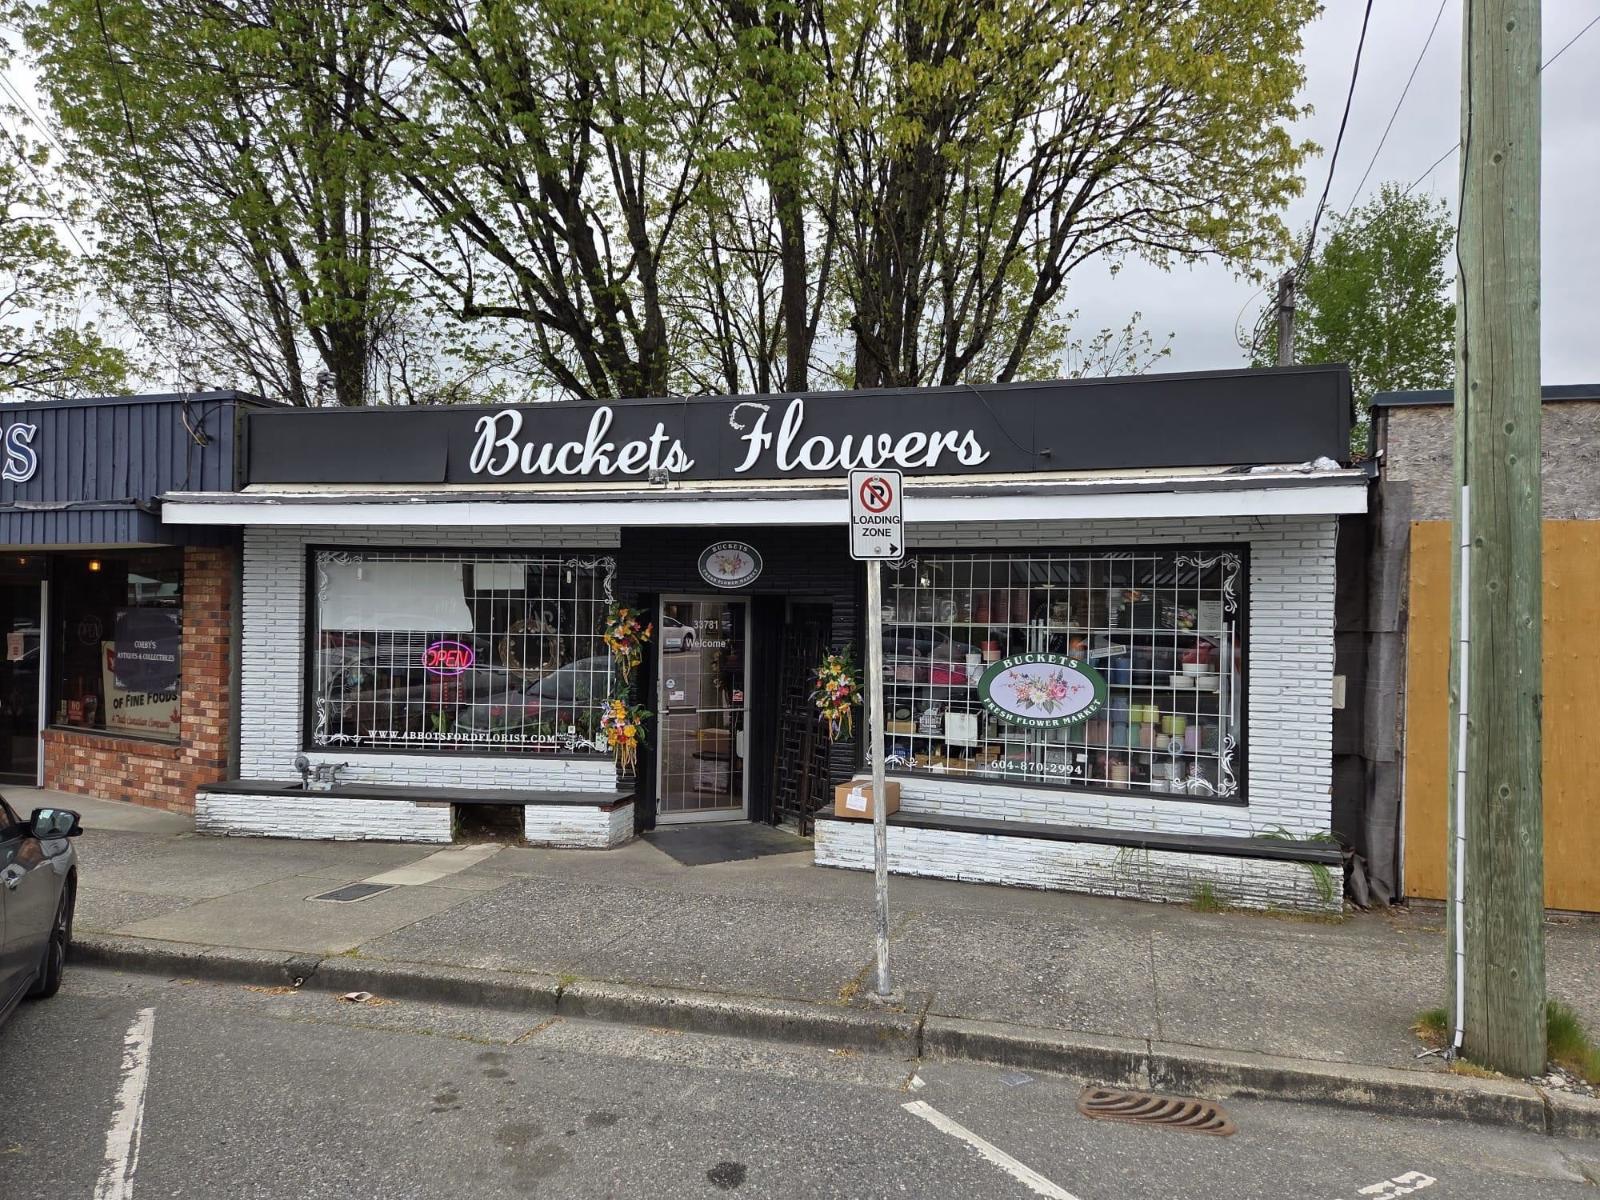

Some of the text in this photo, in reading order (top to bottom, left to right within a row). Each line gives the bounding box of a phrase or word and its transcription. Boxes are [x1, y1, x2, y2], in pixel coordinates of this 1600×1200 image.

[469, 398, 990, 475] Buckets Flowers
[853, 515, 900, 525] LOADING
[862, 527, 892, 537] ZONE
[693, 620, 719, 630] 33781
[685, 638, 726, 648] Welcome
[426, 649, 470, 668] OPEN
[1003, 654, 1079, 669] BUCKETS
[113, 698, 124, 710] OF
[125, 693, 145, 708] FINE
[983, 698, 1101, 727] FRESH FLOWER MARKET
[367, 730, 556, 743] WWW.ABBOTSFORDFLORIST.COM
[991, 759, 1083, 775] 604-870-2994
